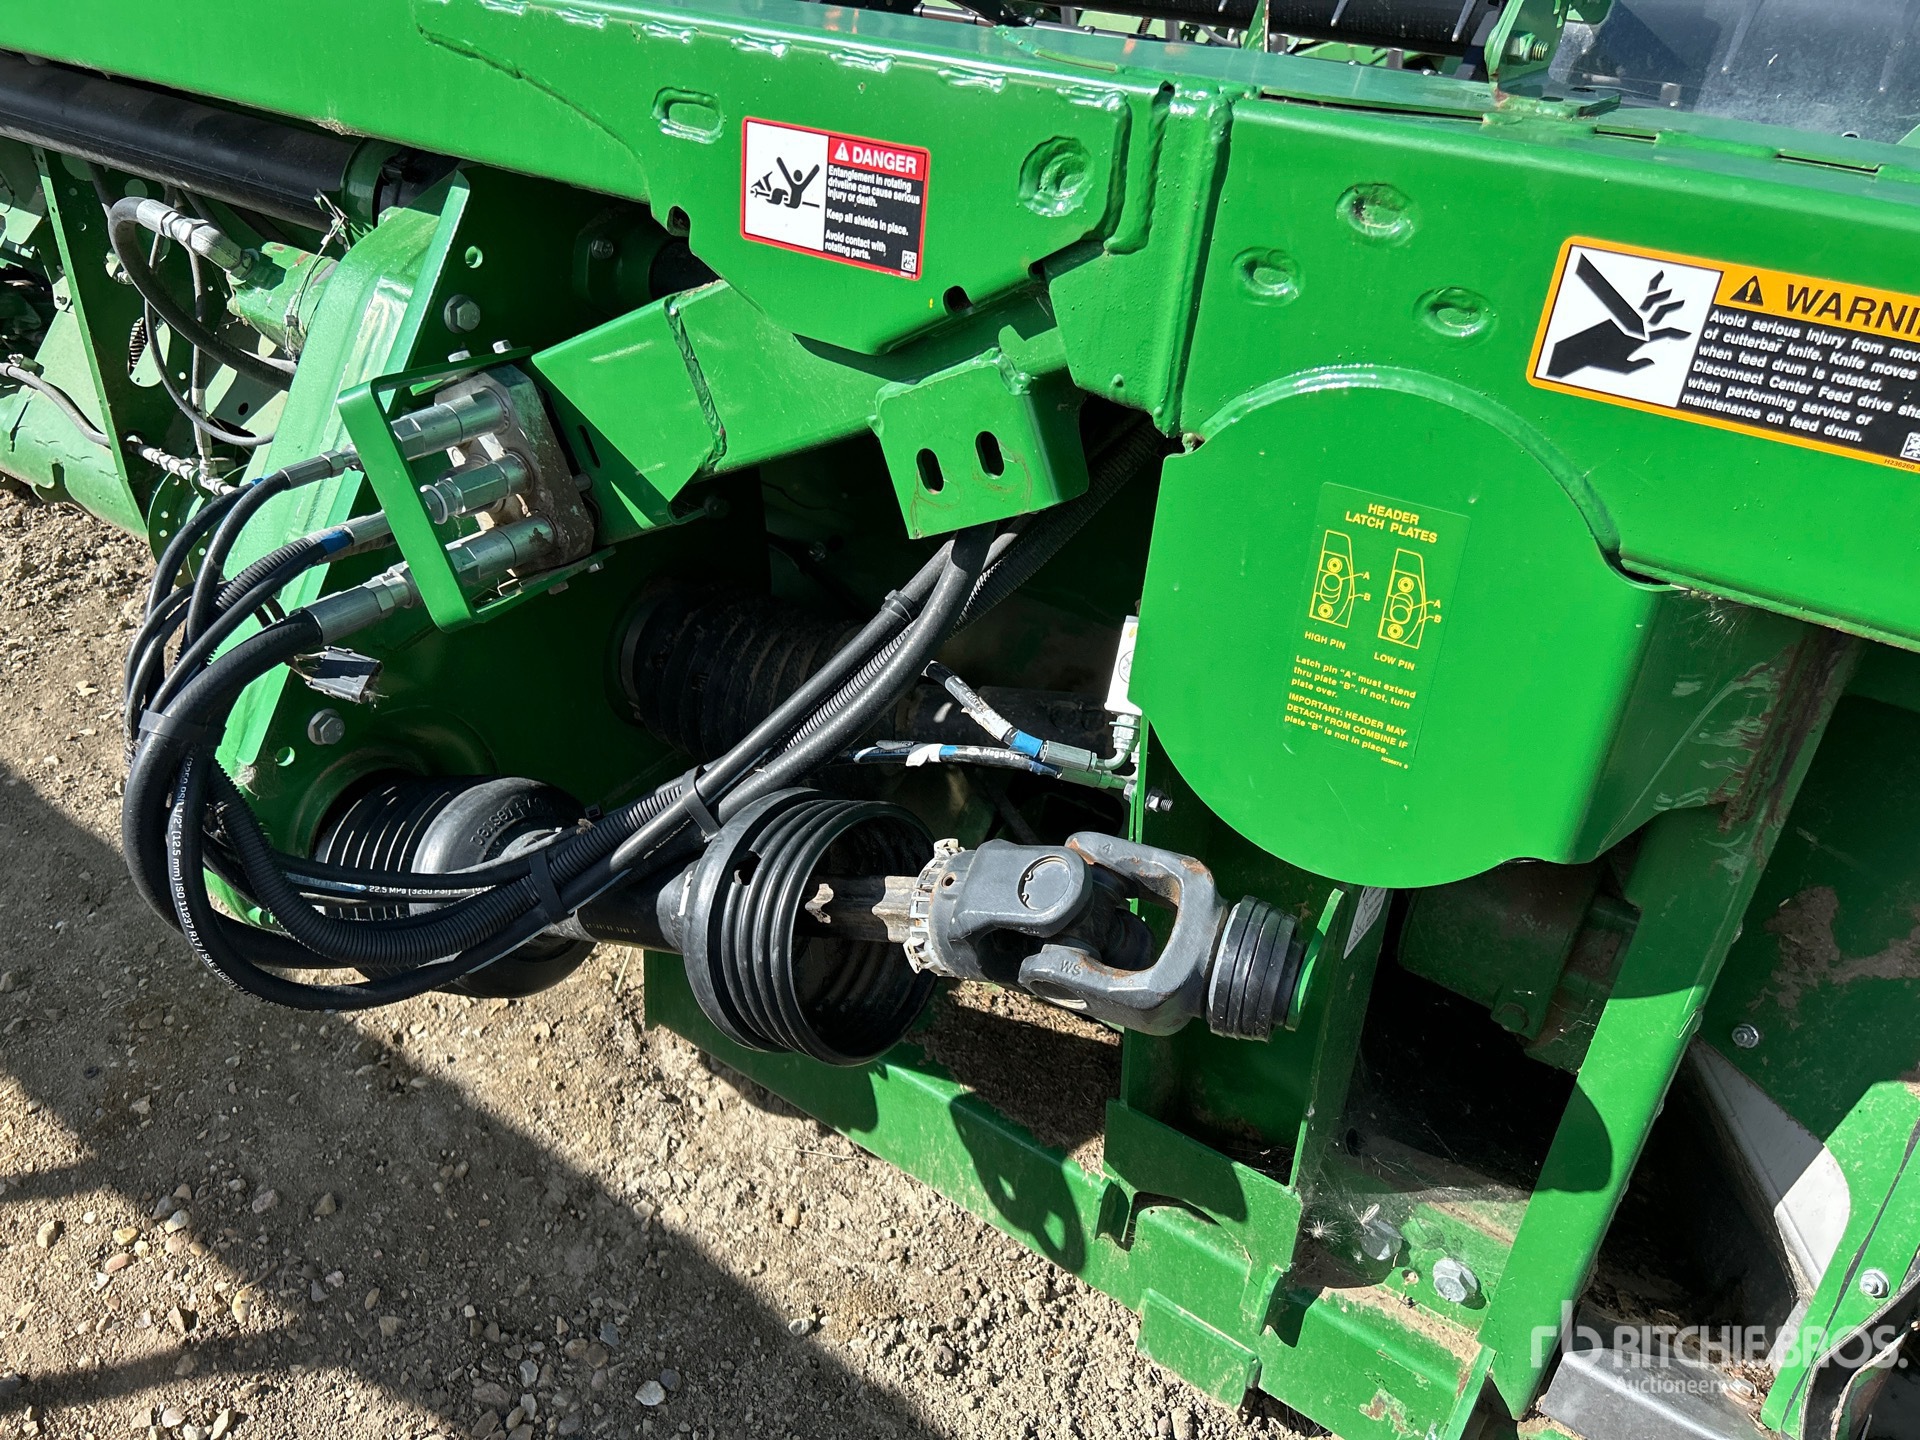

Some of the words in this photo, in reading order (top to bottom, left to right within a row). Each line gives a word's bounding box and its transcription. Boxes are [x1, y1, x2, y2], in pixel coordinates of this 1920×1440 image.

[852, 146, 916, 174] DANGER
[828, 165, 875, 184] Entanglement
[876, 174, 883, 186] in
[884, 176, 912, 193] rotating
[828, 177, 857, 192] driveline
[858, 184, 870, 194] can
[872, 186, 892, 199] cause
[893, 191, 920, 204] serious
[827, 187, 847, 202] injury
[848, 193, 856, 202] or
[856, 194, 878, 207] death.
[826, 208, 844, 223] Keep
[844, 213, 853, 223] all
[854, 215, 878, 229] shields
[880, 220, 886, 231] in
[887, 222, 909, 236] place.
[825, 229, 844, 243] Avoid
[845, 236, 870, 249] contact
[871, 240, 886, 252] with
[825, 242, 850, 257] rotating
[851, 247, 870, 260] parts.
[1787, 284, 1920, 336] WARNI
[1709, 309, 1747, 328] Avoid
[1751, 319, 1801, 338] serious
[1805, 328, 1846, 349] injury
[1851, 337, 1885, 355] from
[1703, 327, 1719, 340] of
[1723, 331, 1783, 353] cutterbar
[1786, 342, 1823, 361] knife.
[1829, 351, 1866, 370] Knife
[1870, 362, 1918, 380] moves
[1698, 344, 1732, 360] when
[1738, 350, 1768, 368] feed
[1771, 358, 1807, 376] drum
[1812, 366, 1826, 380] is
[1831, 372, 1882, 392] rotated.
[1693, 359, 1764, 385] Disconnect
[1769, 375, 1814, 395] Center
[1818, 386, 1853, 404] Feed
[1857, 395, 1893, 412] drive
[1687, 377, 1722, 393] when
[1725, 385, 1797, 412] performing
[1802, 402, 1851, 421] service
[1856, 414, 1873, 426] or
[1681, 392, 1762, 419] maintenance
[1766, 411, 1784, 424] on
[1789, 414, 1820, 432] feed
[1823, 424, 1862, 442] drum.
[1345, 510, 1385, 530] LATCH
[1390, 522, 1438, 543] PLATES
[1368, 503, 1419, 525] HEADER
[1363, 571, 1370, 580] A
[1364, 593, 1371, 601] B
[1433, 599, 1441, 608] A
[1434, 614, 1442, 624] B
[1304, 631, 1328, 644] HIGH
[1330, 638, 1346, 650] PIN
[1373, 652, 1396, 665] LOW
[1397, 659, 1415, 671] PIN
[1291, 678, 1314, 690] plate
[1315, 686, 1338, 698] over.
[1294, 666, 1312, 678] thru
[1314, 674, 1337, 686] plate
[1369, 691, 1388, 703] not,
[1390, 697, 1411, 710] turn
[1296, 655, 1321, 669] Latch
[1322, 664, 1338, 674] pin
[1358, 675, 1381, 688] must
[1383, 683, 1417, 699] extend
[1286, 703, 1322, 720] DETACH
[1324, 716, 1351, 730] FROM
[1352, 725, 1396, 746] COMBINE
[1398, 740, 1408, 749] IF
[1288, 692, 1343, 716] IMPORTANT:
[1344, 710, 1384, 730] HEADER
[1386, 724, 1407, 736] MAY
[1284, 715, 1306, 727] plate
[1324, 727, 1332, 736] is
[1334, 731, 1349, 742] not
[1351, 736, 1360, 745] in
[1361, 740, 1389, 755] place.
[172, 858, 183, 880] mm)
[178, 900, 194, 929] 11237
[188, 930, 204, 947] R17
